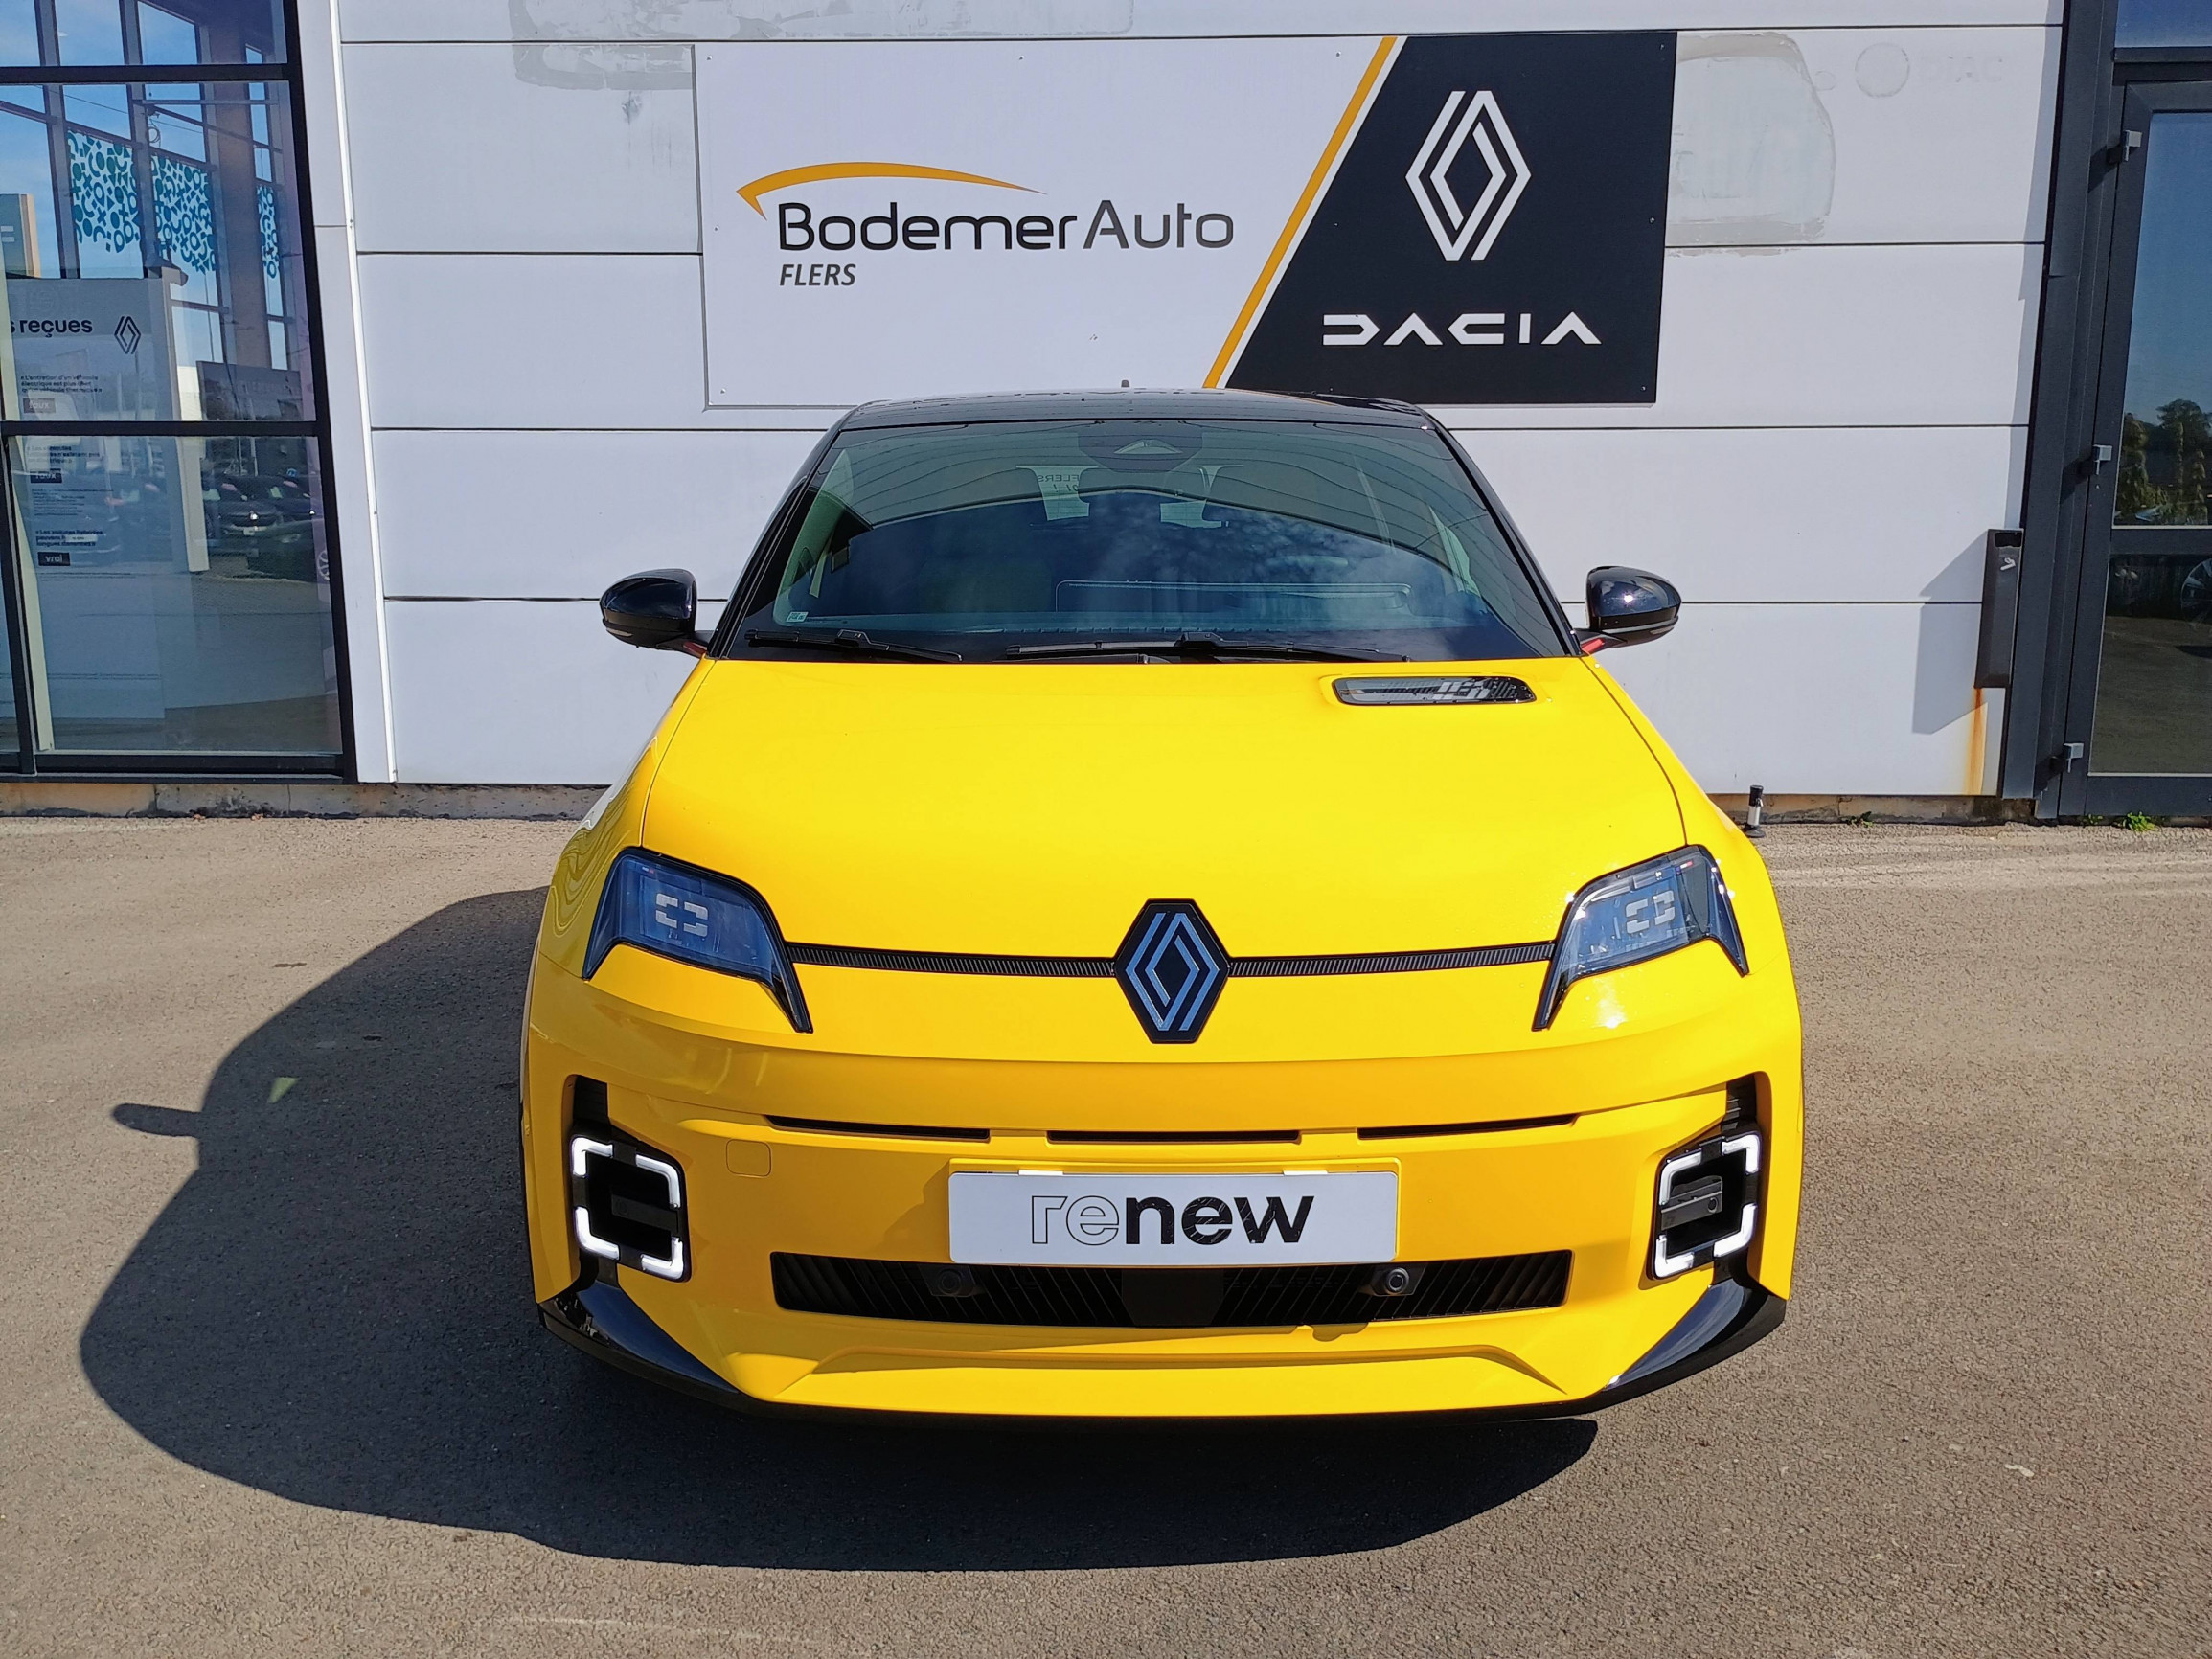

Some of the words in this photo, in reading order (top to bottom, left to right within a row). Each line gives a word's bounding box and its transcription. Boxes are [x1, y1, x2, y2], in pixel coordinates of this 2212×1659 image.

[779, 263, 857, 286] FLERS
[19, 319, 93, 338] reçues
[1322, 311, 1603, 346] DACIA
[29, 400, 49, 409] faux
[45, 554, 63, 562] vrai
[1031, 1194, 1314, 1246] renew
